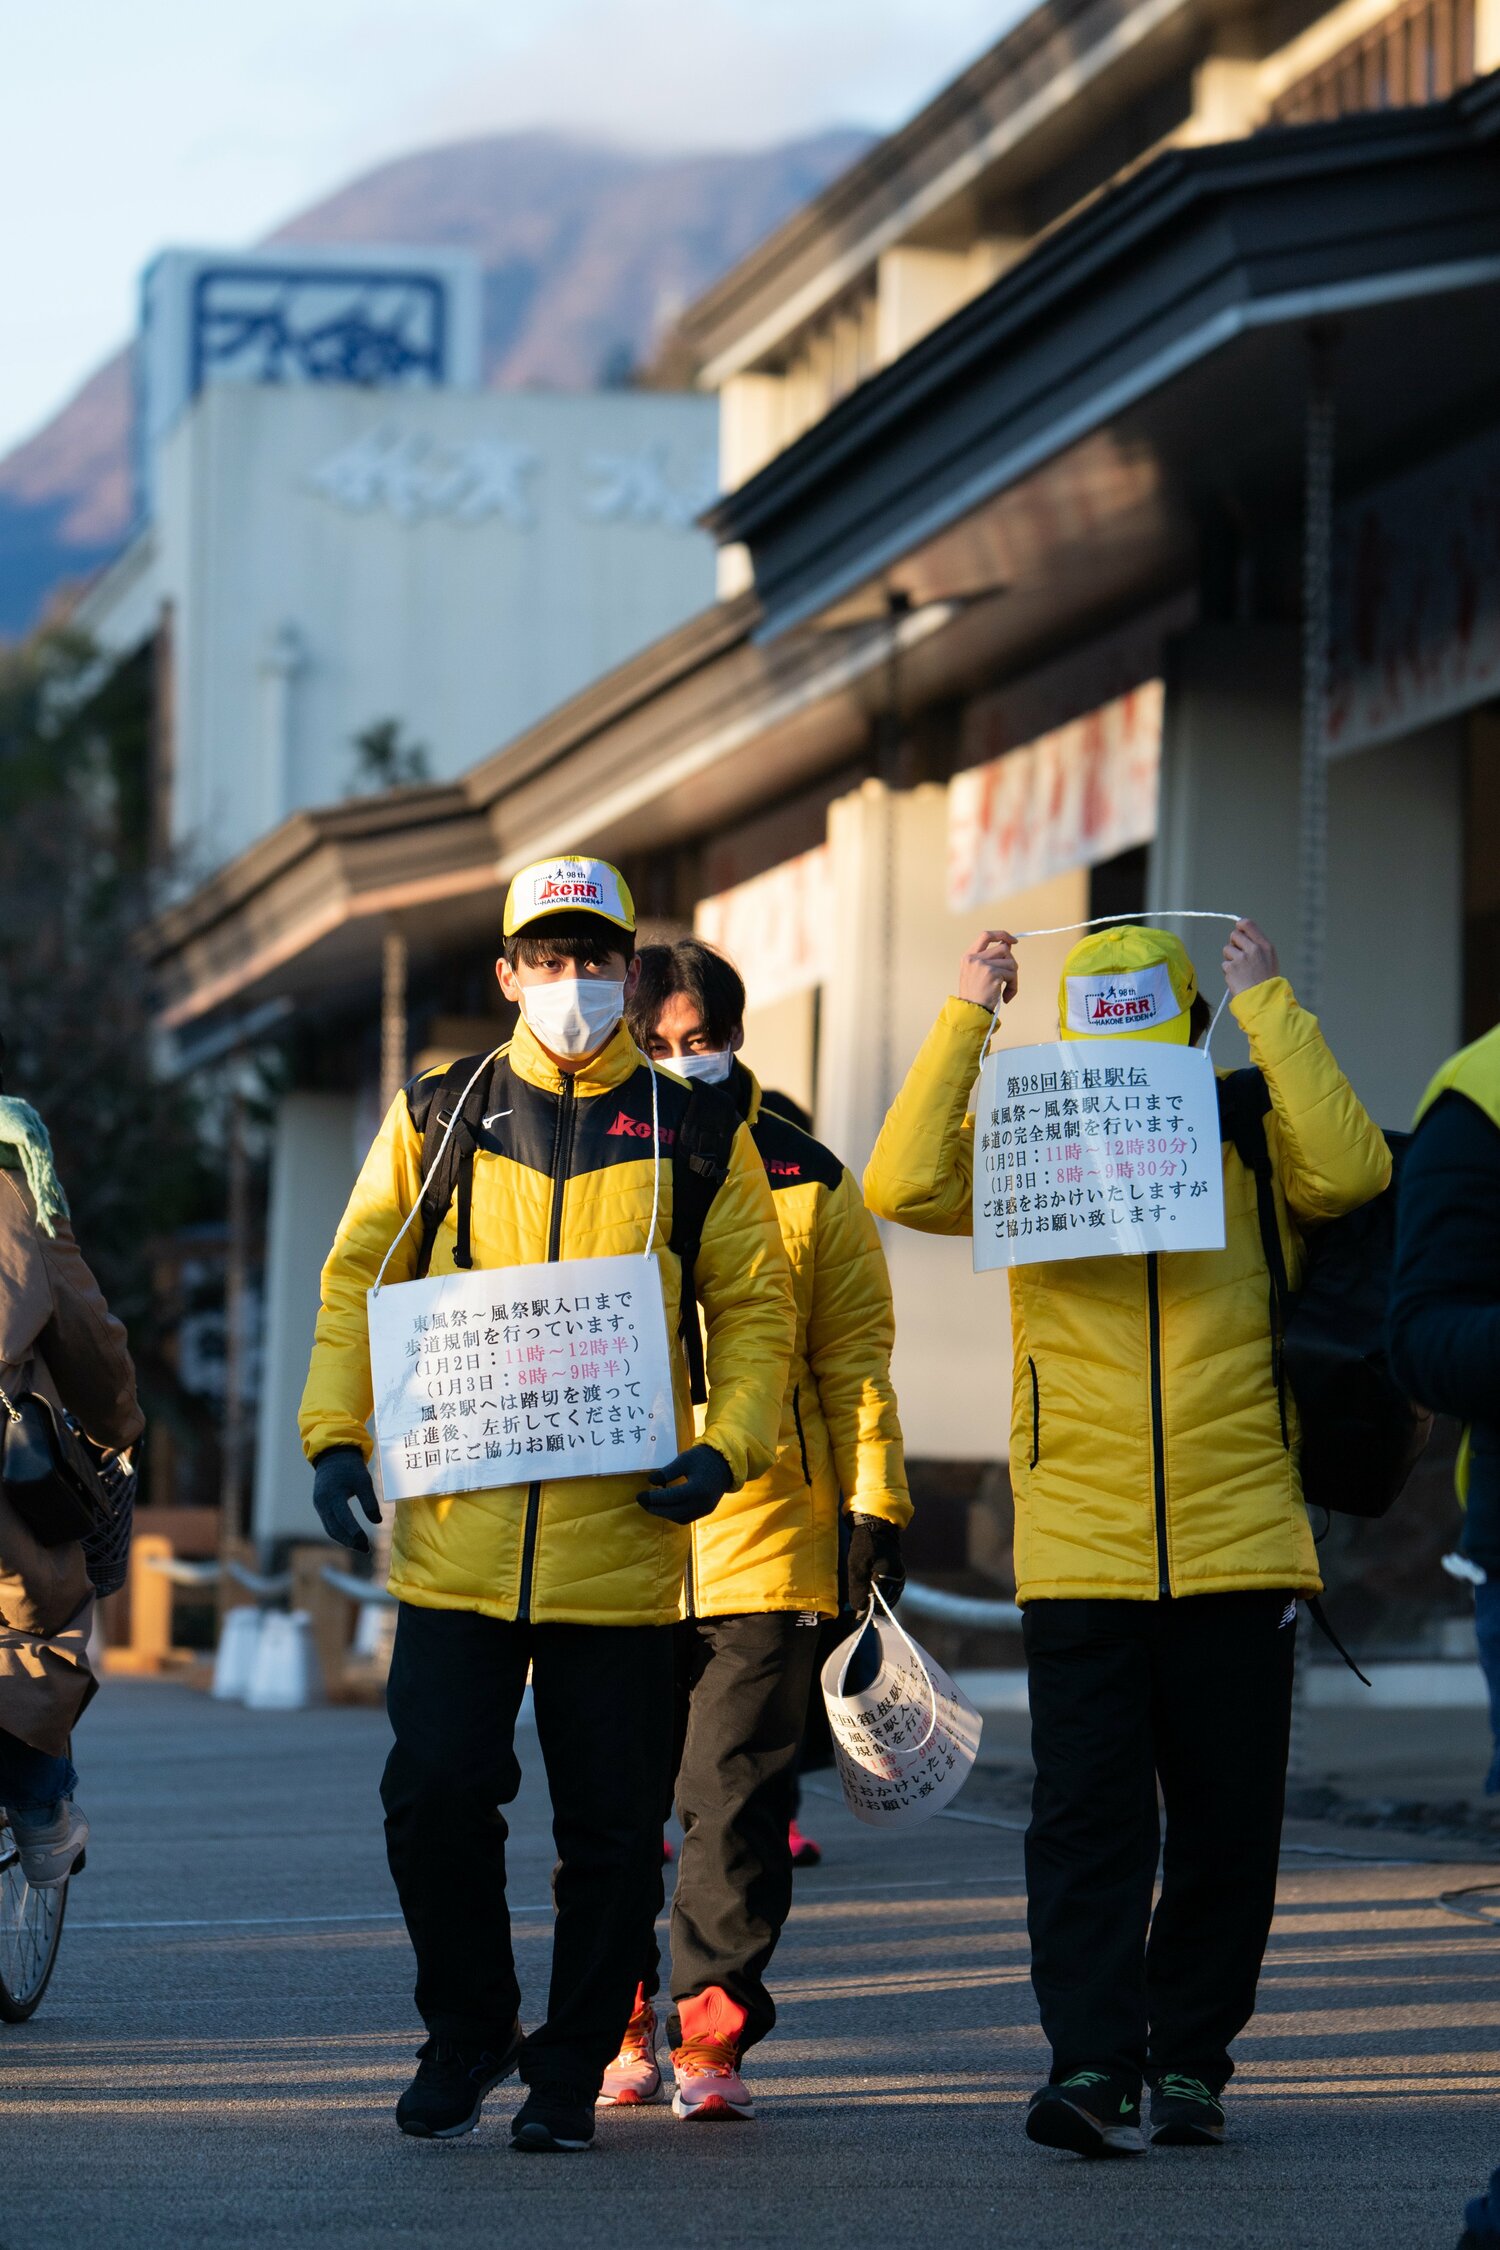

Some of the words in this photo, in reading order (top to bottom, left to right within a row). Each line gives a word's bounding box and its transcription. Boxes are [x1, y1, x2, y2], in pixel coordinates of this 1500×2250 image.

[542, 897, 570, 906] HAKONE
[571, 896, 597, 905] EKIDEN
[1096, 1017, 1124, 1026] HAKONE
[1125, 1014, 1150, 1023] EKIDEN
[1007, 1067, 1149, 1096] 第98回箱根駅伝
[981, 1115, 1195, 1151] 歩道の完全規制を行います。
[983, 1180, 1208, 1218] ご迷惑をおかけいたしますが
[994, 1204, 1177, 1238] ご協力お願い致します。
[404, 1317, 636, 1358] 歩道規制を行っています。
[420, 1380, 642, 1422] 風祭駅へは踏切を渡って
[402, 1403, 655, 1448] 直進後、左折してください。
[404, 1425, 658, 1470] 迂回にご協力お願いします。
